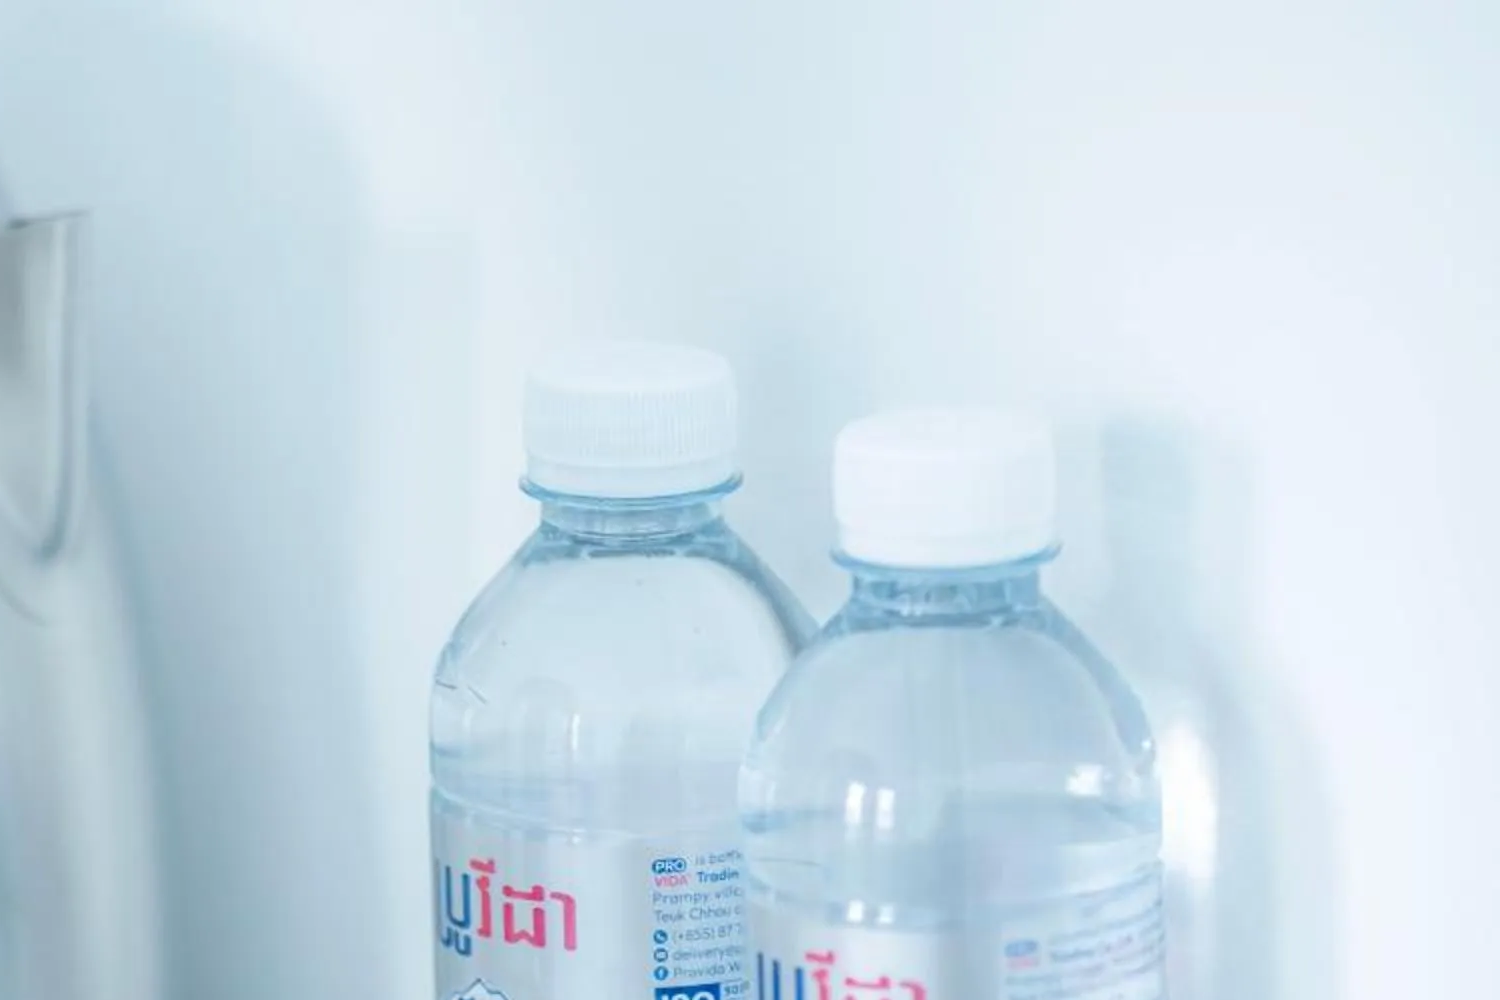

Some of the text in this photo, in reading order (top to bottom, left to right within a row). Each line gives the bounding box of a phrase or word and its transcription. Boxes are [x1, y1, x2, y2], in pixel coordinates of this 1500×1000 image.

[652, 858, 687, 874] PRO
[654, 875, 688, 888] VIDA
[697, 867, 740, 883] Tradin
